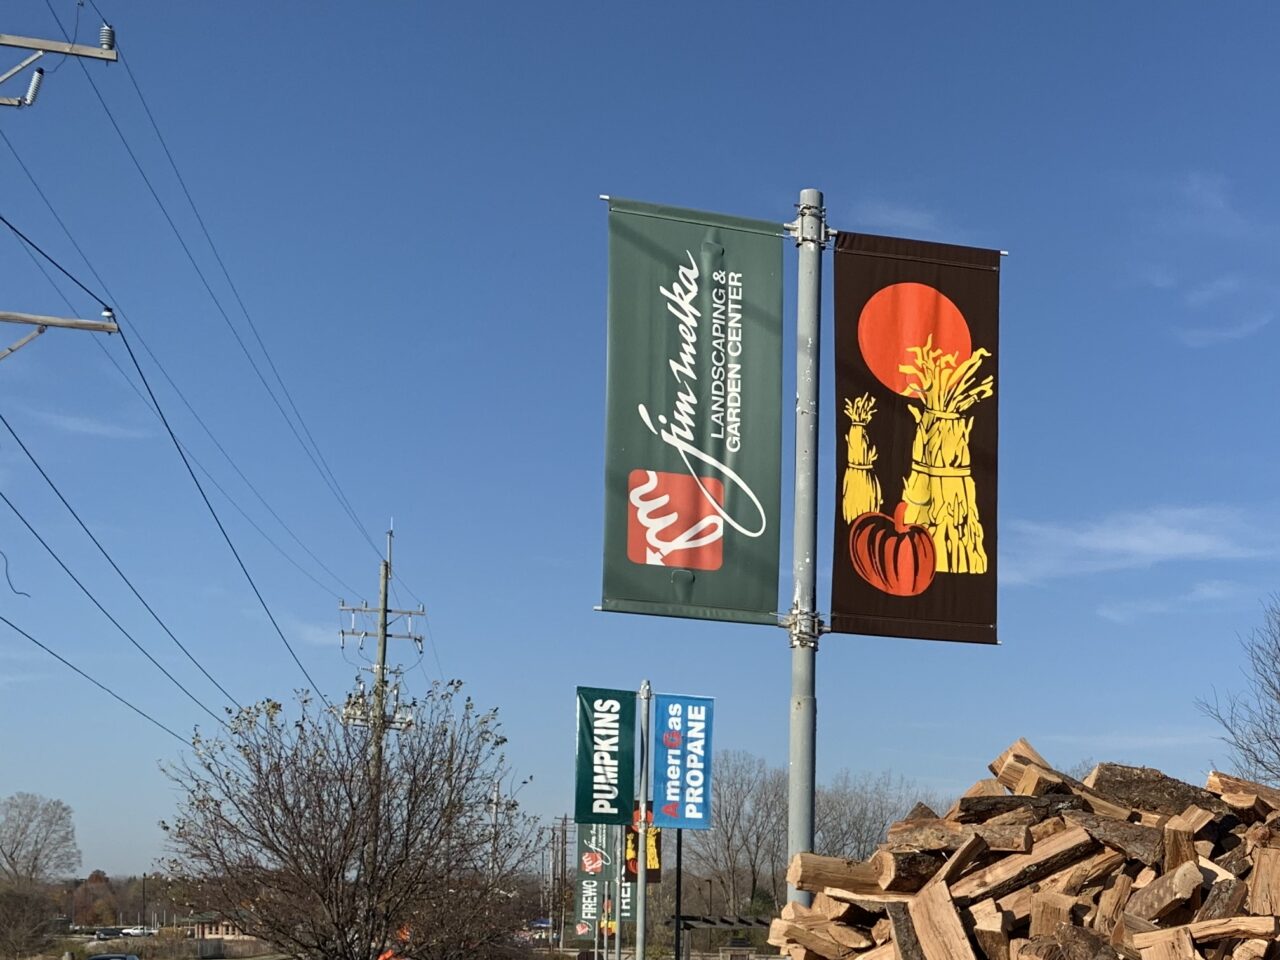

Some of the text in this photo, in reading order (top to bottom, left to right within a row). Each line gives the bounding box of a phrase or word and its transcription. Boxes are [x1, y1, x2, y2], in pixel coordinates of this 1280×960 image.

[710, 269, 727, 440] LANDSCAPING &
[726, 272, 744, 453] GARDEN CENTER
[592, 698, 621, 814] PUMPKINS
[661, 703, 682, 818] AmeriGas
[684, 705, 706, 819] PROPANE
